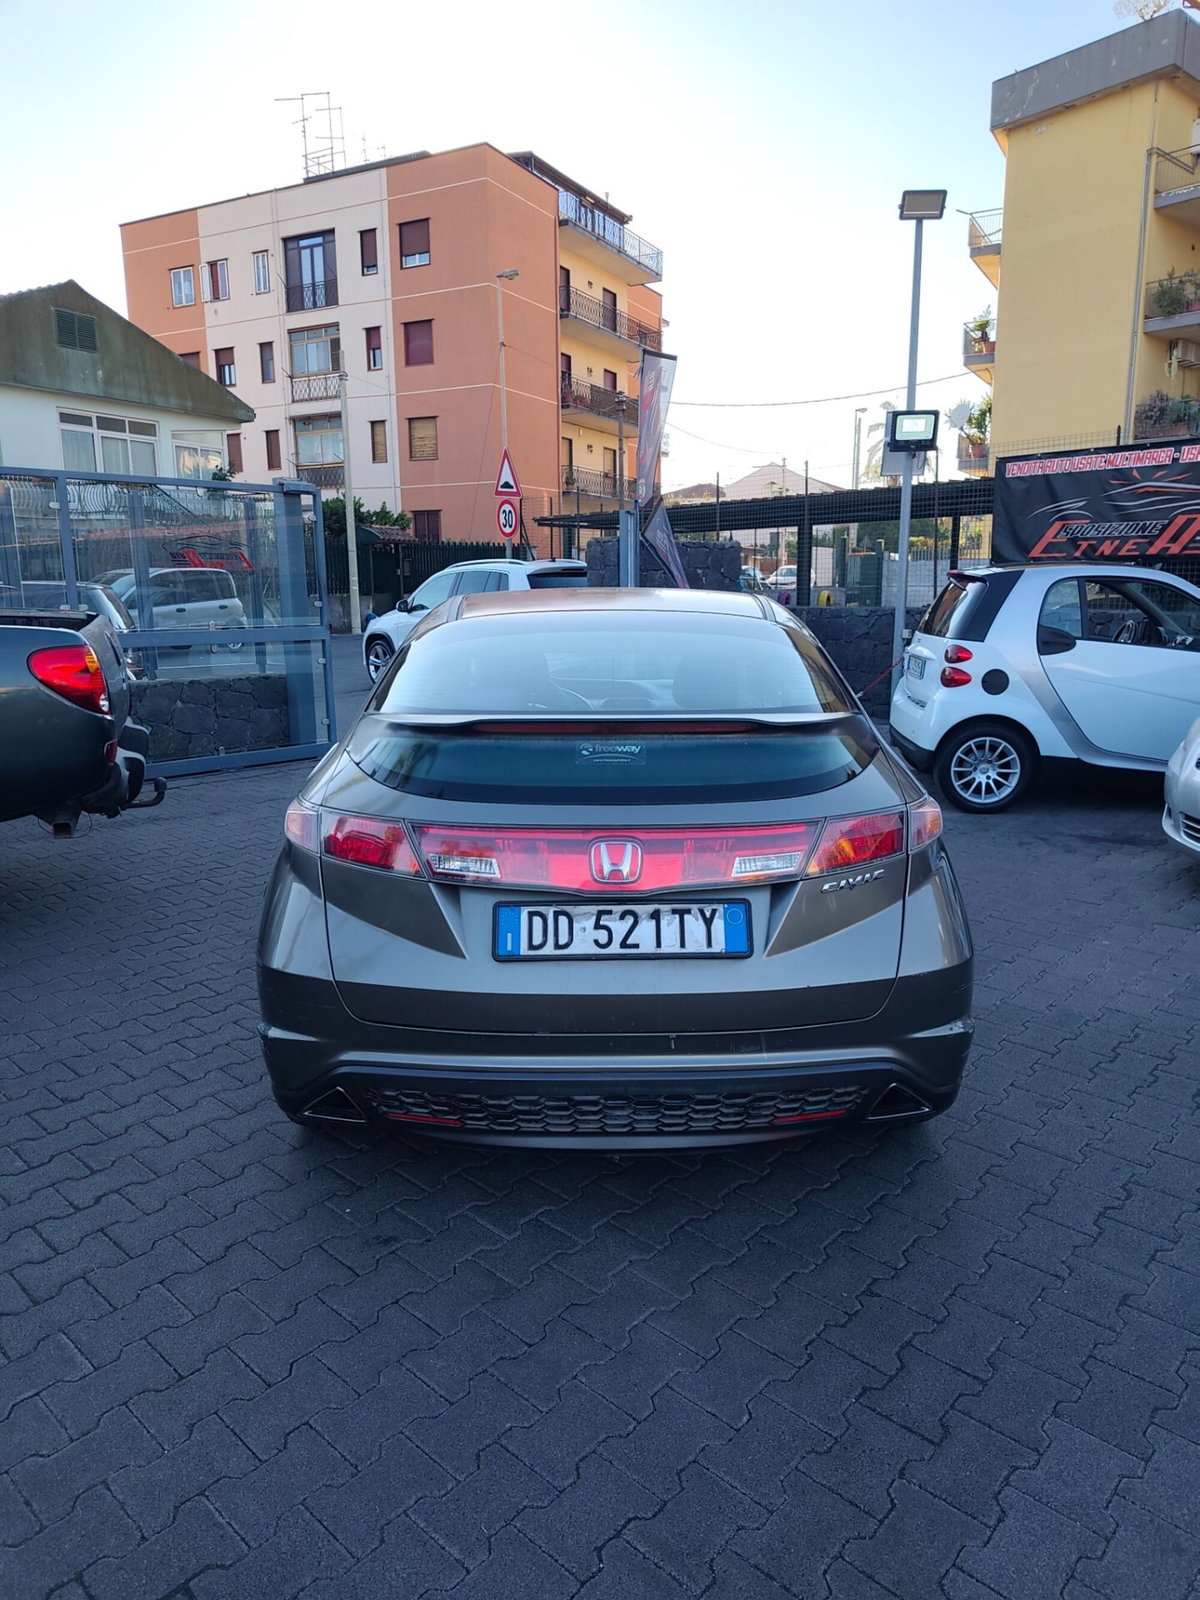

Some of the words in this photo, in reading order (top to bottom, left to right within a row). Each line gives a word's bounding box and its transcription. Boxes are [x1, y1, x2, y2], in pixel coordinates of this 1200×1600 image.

[1005, 460, 1045, 477] VENDITA
[1044, 457, 1072, 474] AUTO
[1071, 454, 1106, 472] USATE
[1105, 448, 1174, 469] MULTIMARCA
[502, 509, 513, 529] 30
[595, 744, 641, 754] freeway
[820, 869, 885, 893] CIVIC
[527, 910, 574, 951] DD
[593, 908, 718, 950] 521TY
